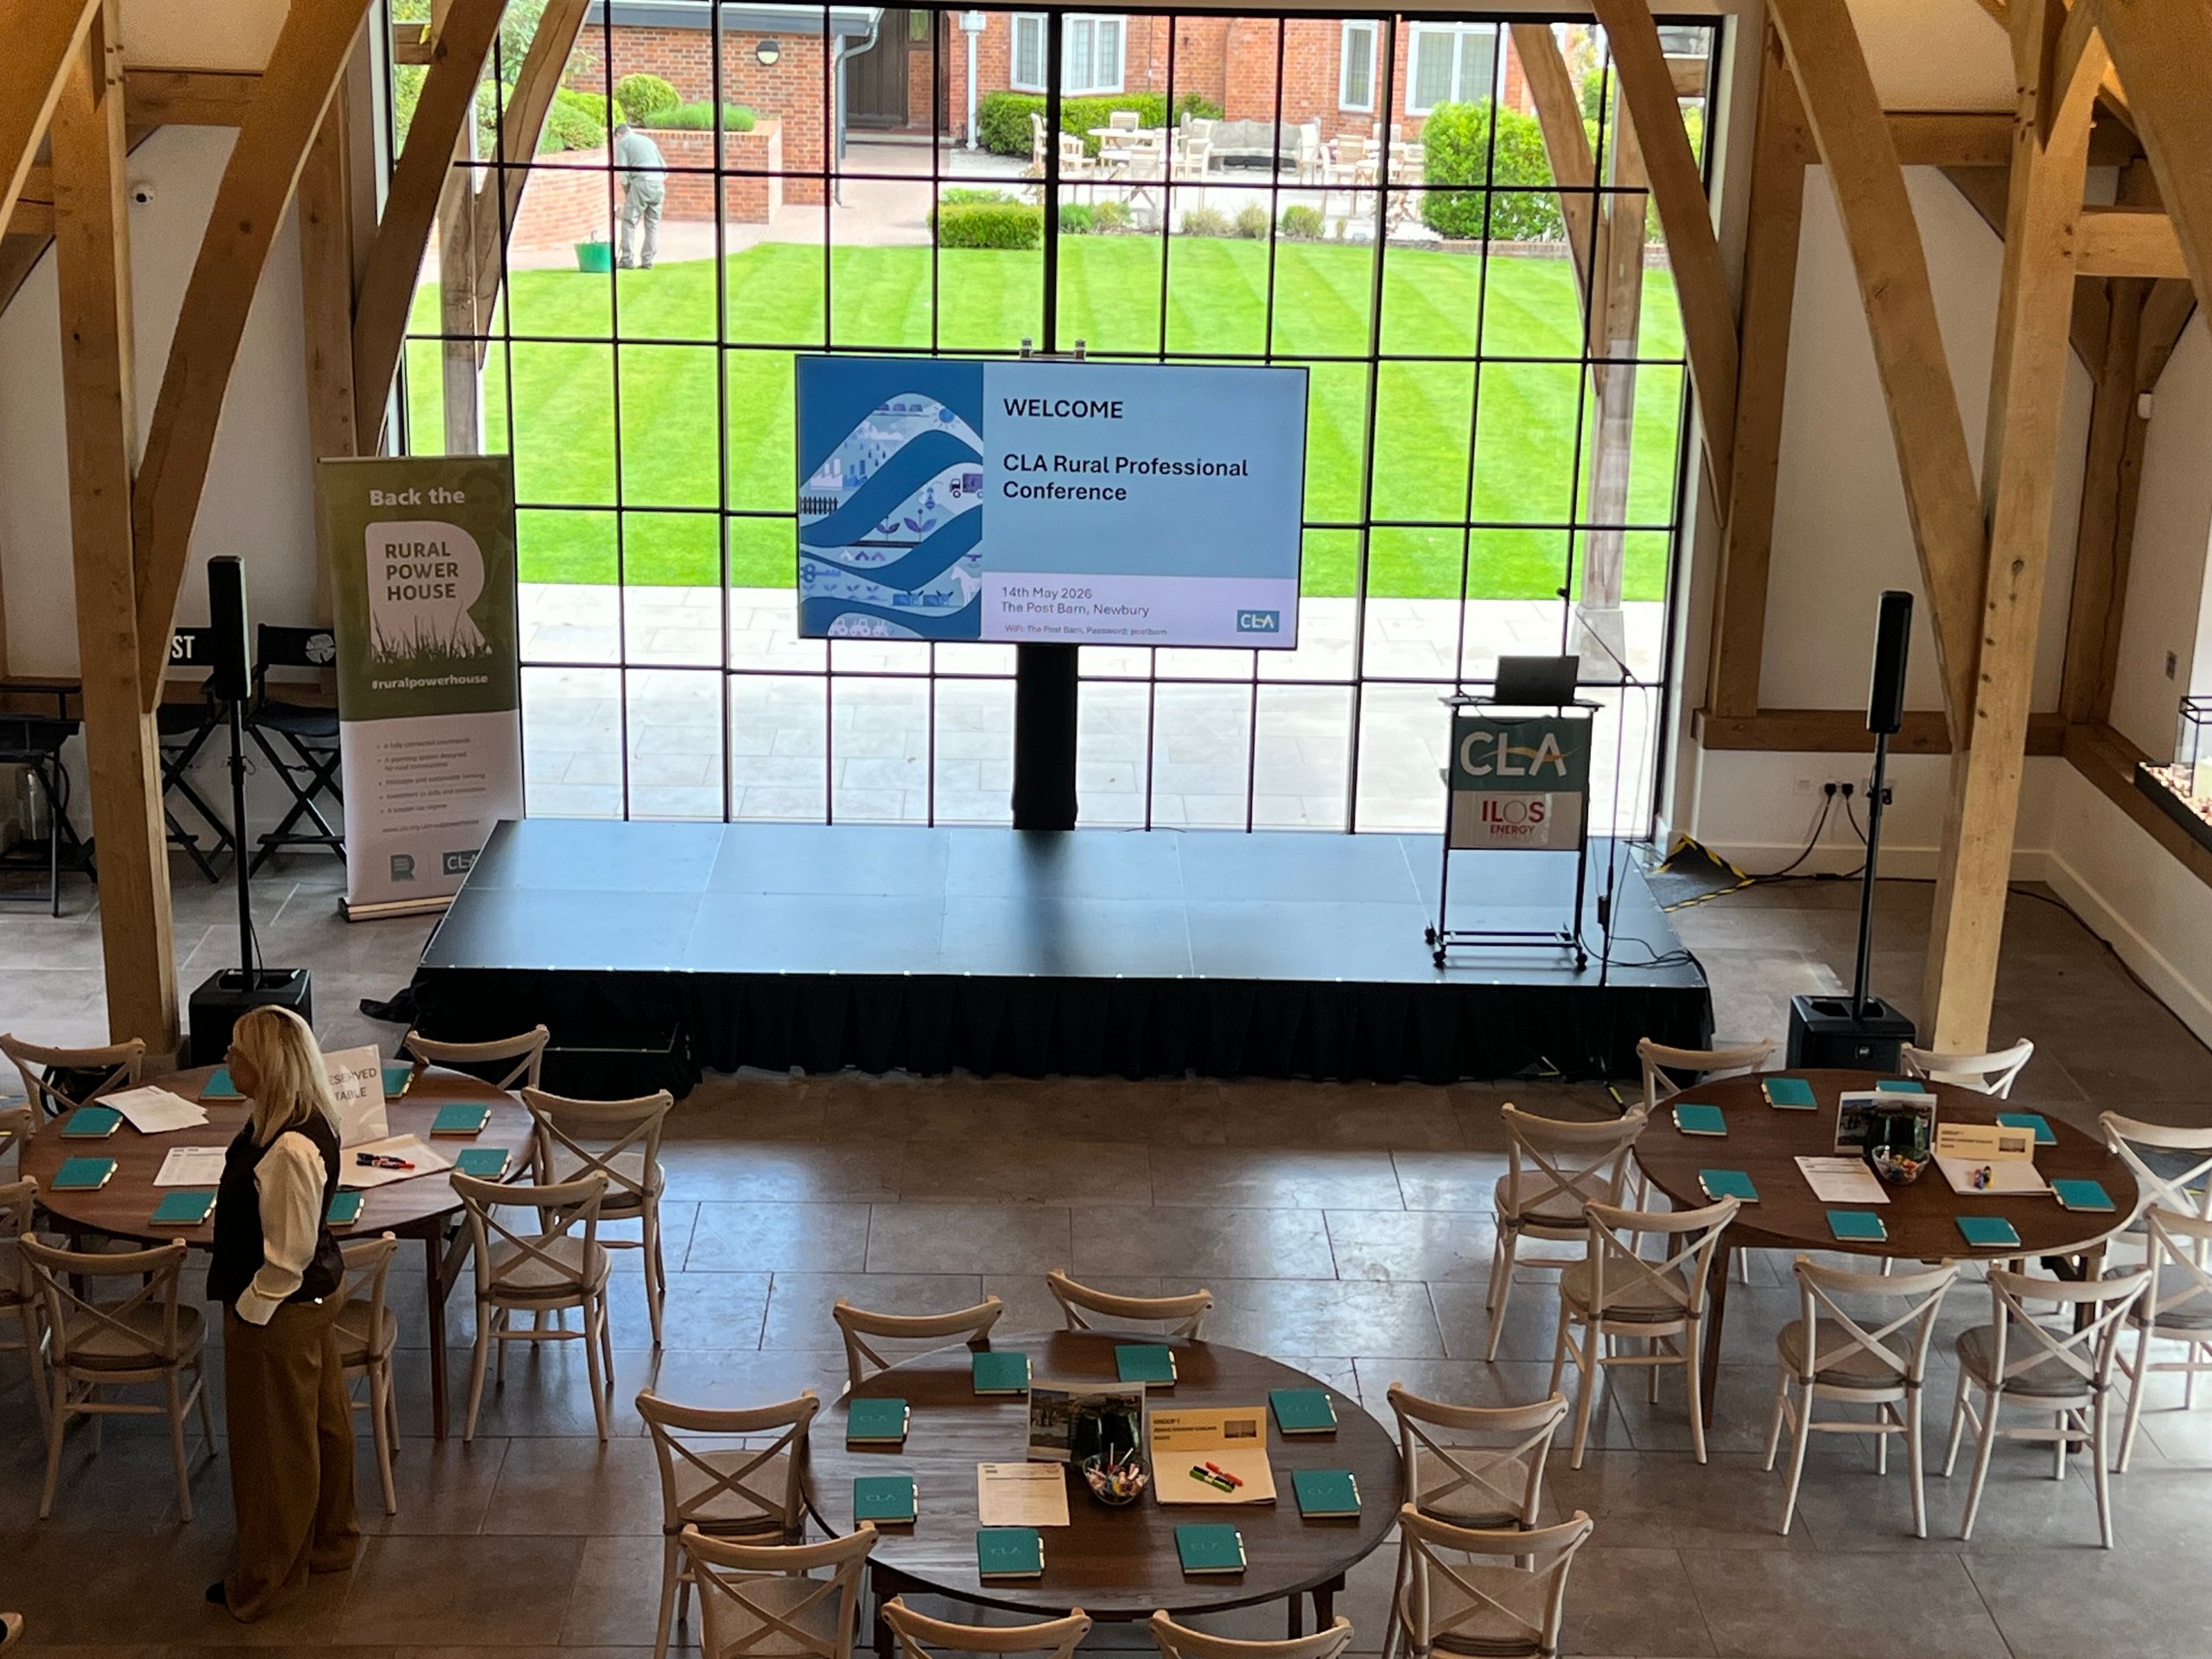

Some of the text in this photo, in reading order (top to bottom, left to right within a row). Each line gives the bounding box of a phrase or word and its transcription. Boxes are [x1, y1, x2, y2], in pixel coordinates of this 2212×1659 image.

[1003, 398, 1123, 419] WELCOME
[1003, 454, 1249, 476] CLA Rural Professional
[369, 486, 465, 506] Back the
[1003, 480, 1127, 500] Conference
[385, 541, 451, 559] RURAL
[386, 562, 459, 580] POWER
[387, 583, 456, 601] HOUSE
[1002, 587, 1092, 601] 14th May 2026
[1001, 601, 1149, 618] The Post Barn, Newbury
[1027, 625, 1042, 633] The
[1240, 613, 1274, 629] CLA
[372, 674, 488, 690] #ruralpowerhouse
[1460, 731, 1567, 777] CLA
[1481, 799, 1545, 824] ILOS
[1490, 824, 1535, 835] ENERGY
[328, 1068, 378, 1086] ESERVED
[334, 1086, 367, 1101] TABLE
